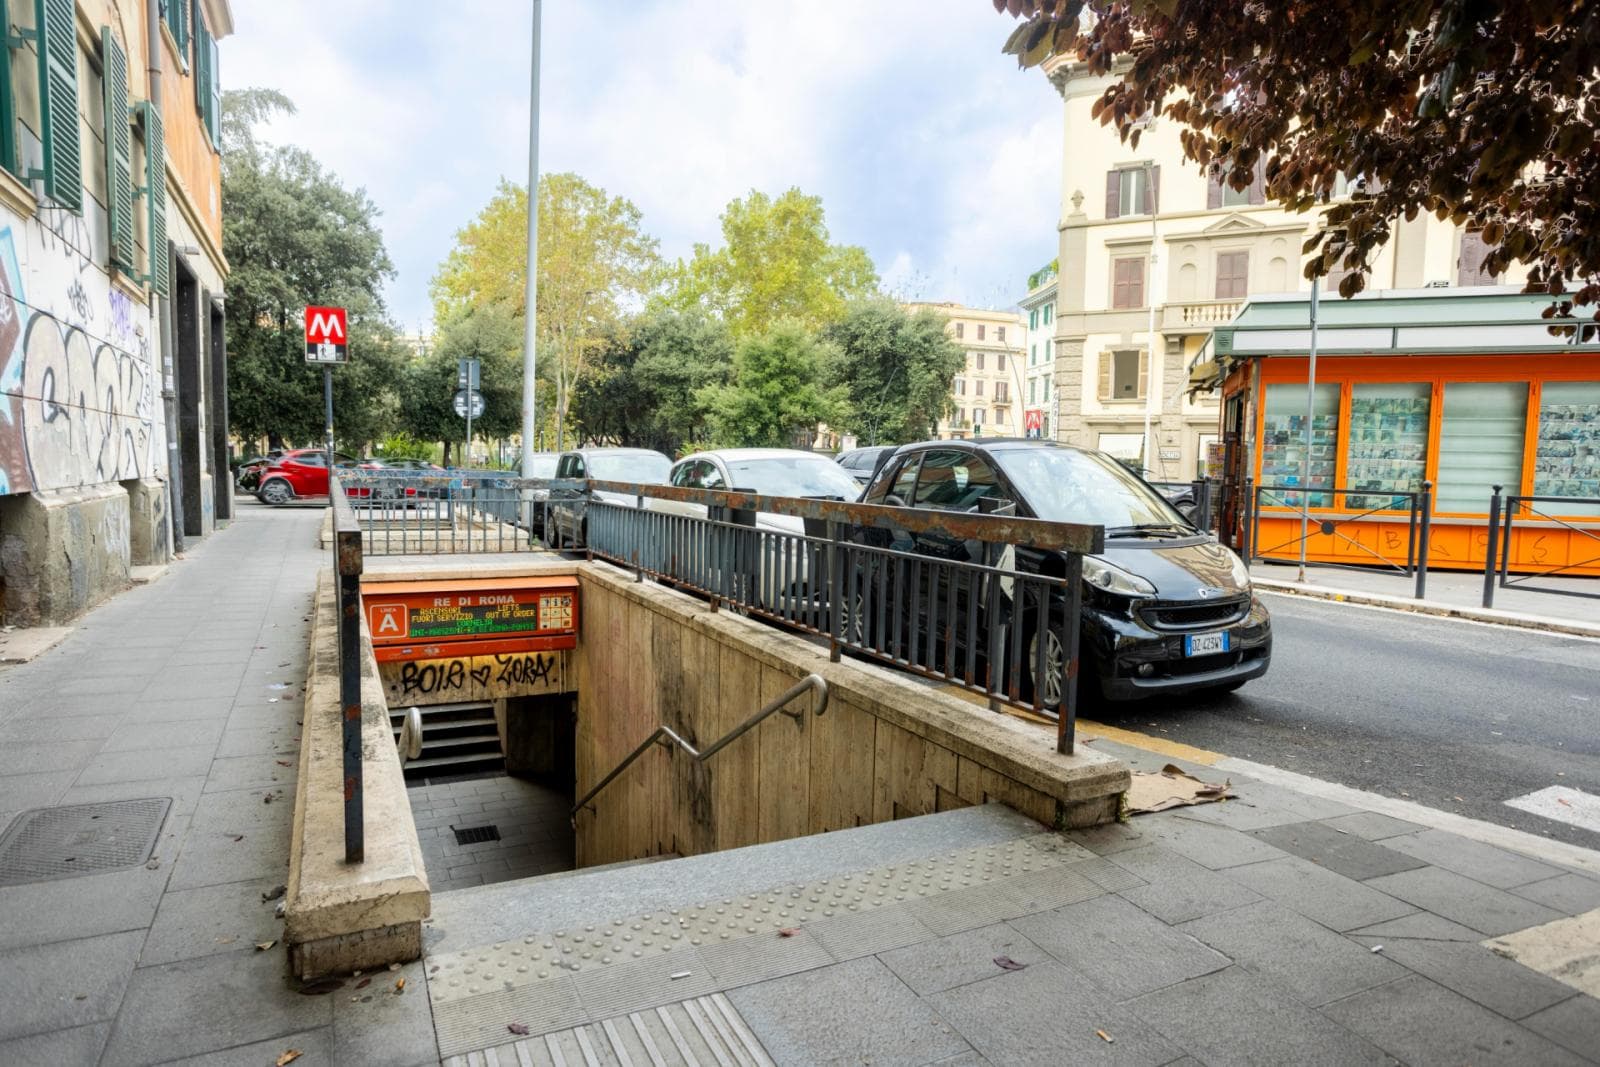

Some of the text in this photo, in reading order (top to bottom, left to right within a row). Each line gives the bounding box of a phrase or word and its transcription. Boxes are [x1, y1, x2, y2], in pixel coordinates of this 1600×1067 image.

[309, 313, 344, 338] M
[434, 595, 515, 607] RE DI ROMA
[420, 606, 461, 616] ASCENSORI
[497, 603, 520, 612] LIFTS
[411, 612, 473, 623] FUORI SERVIZIO
[485, 611, 500, 619] OUT
[379, 613, 399, 633] A
